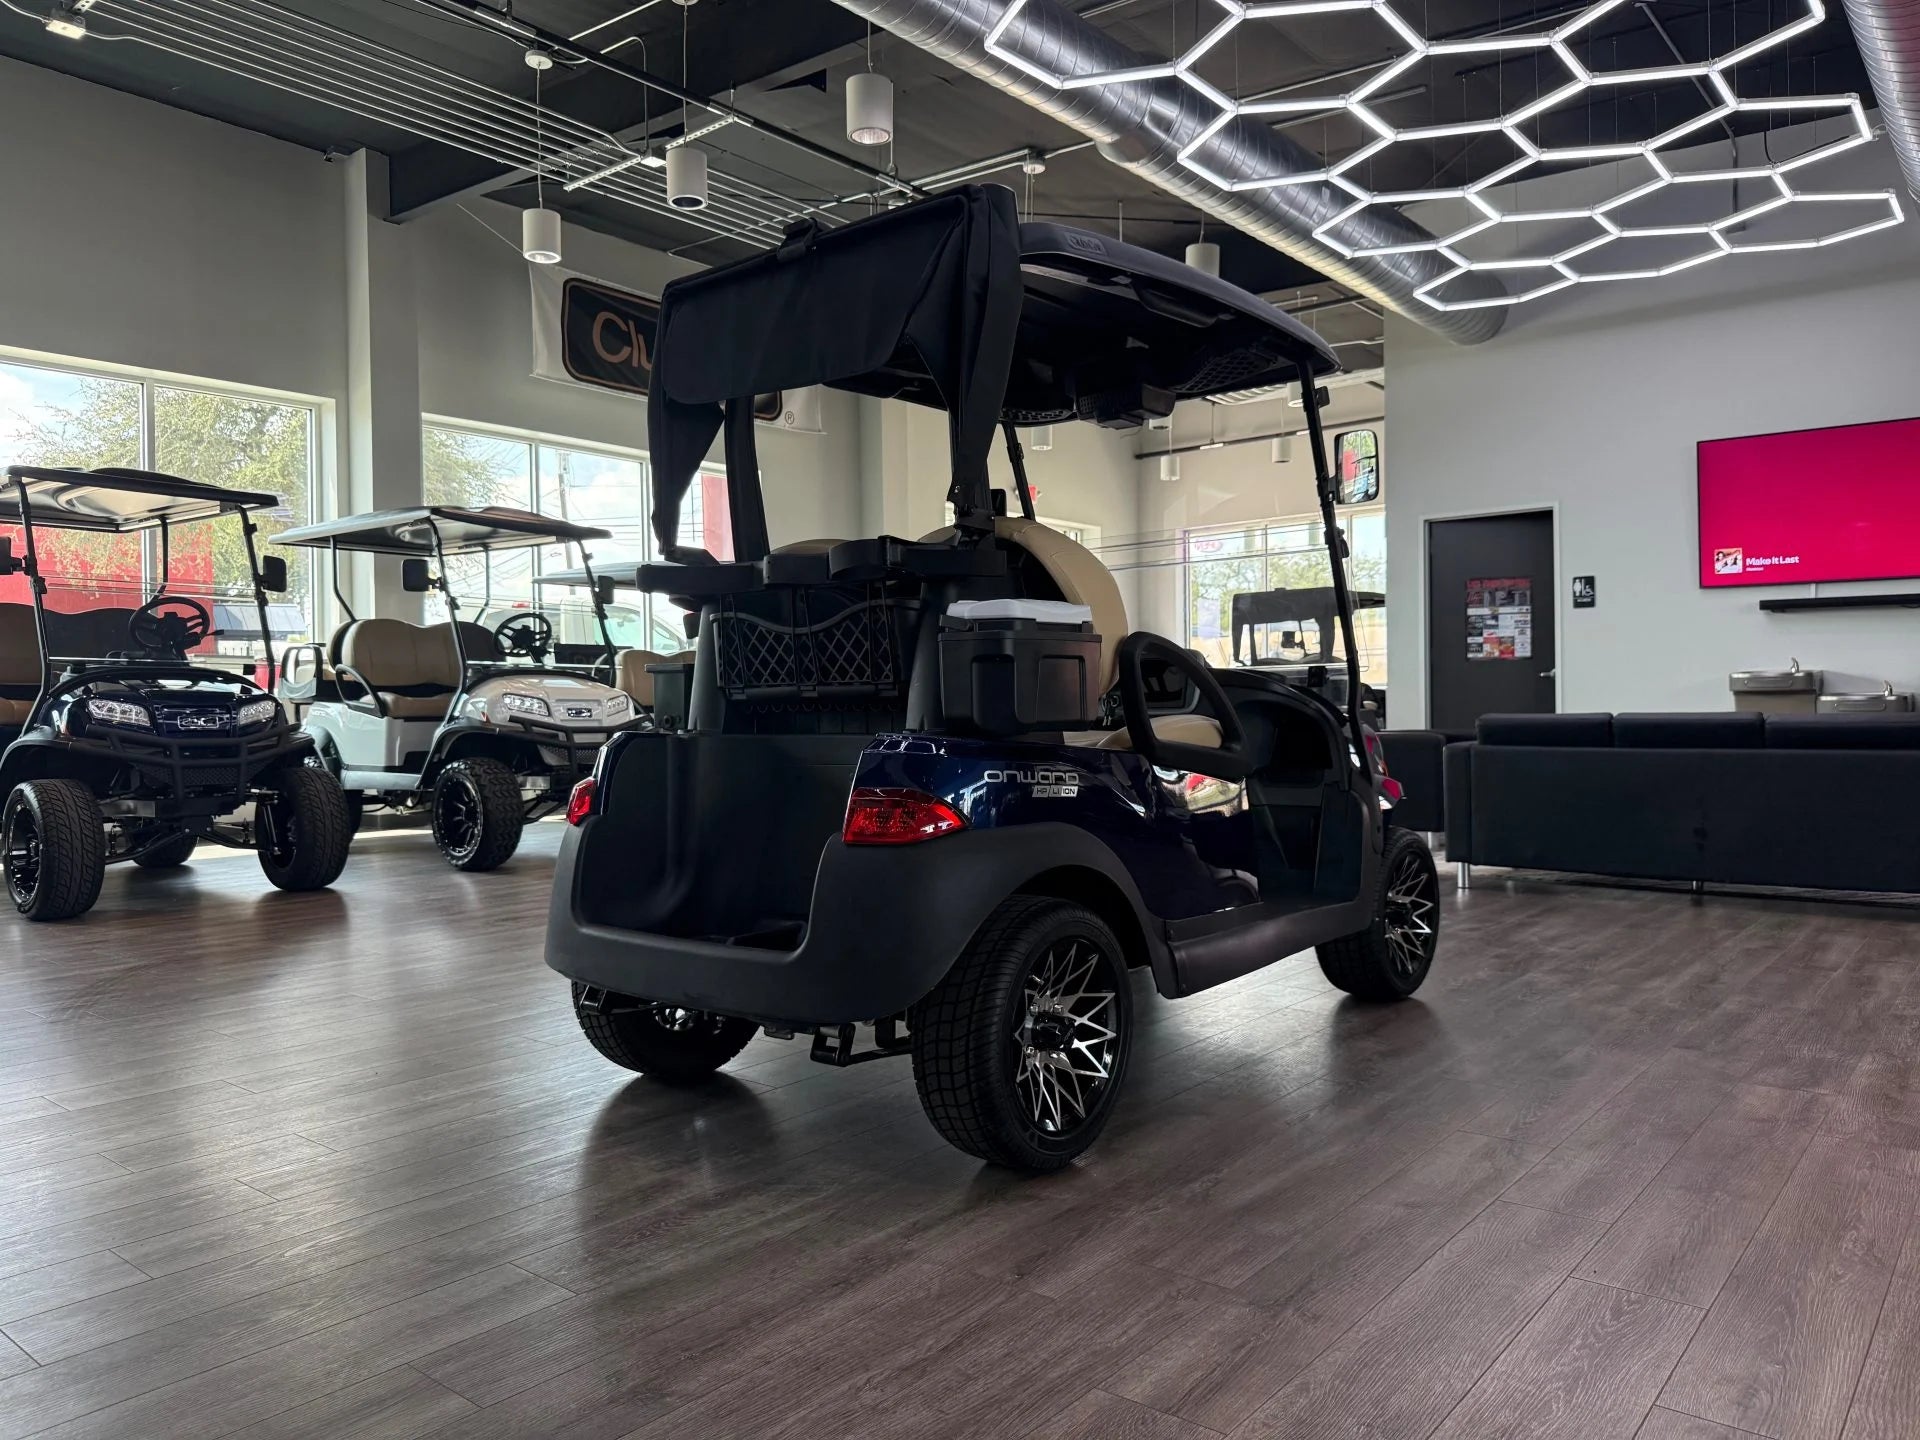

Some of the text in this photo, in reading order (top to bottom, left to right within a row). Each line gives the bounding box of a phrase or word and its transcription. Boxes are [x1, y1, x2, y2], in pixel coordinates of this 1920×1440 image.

[1746, 557, 1771, 566] Make
[1779, 556, 1799, 564] Last
[1062, 787, 1076, 795] ION
